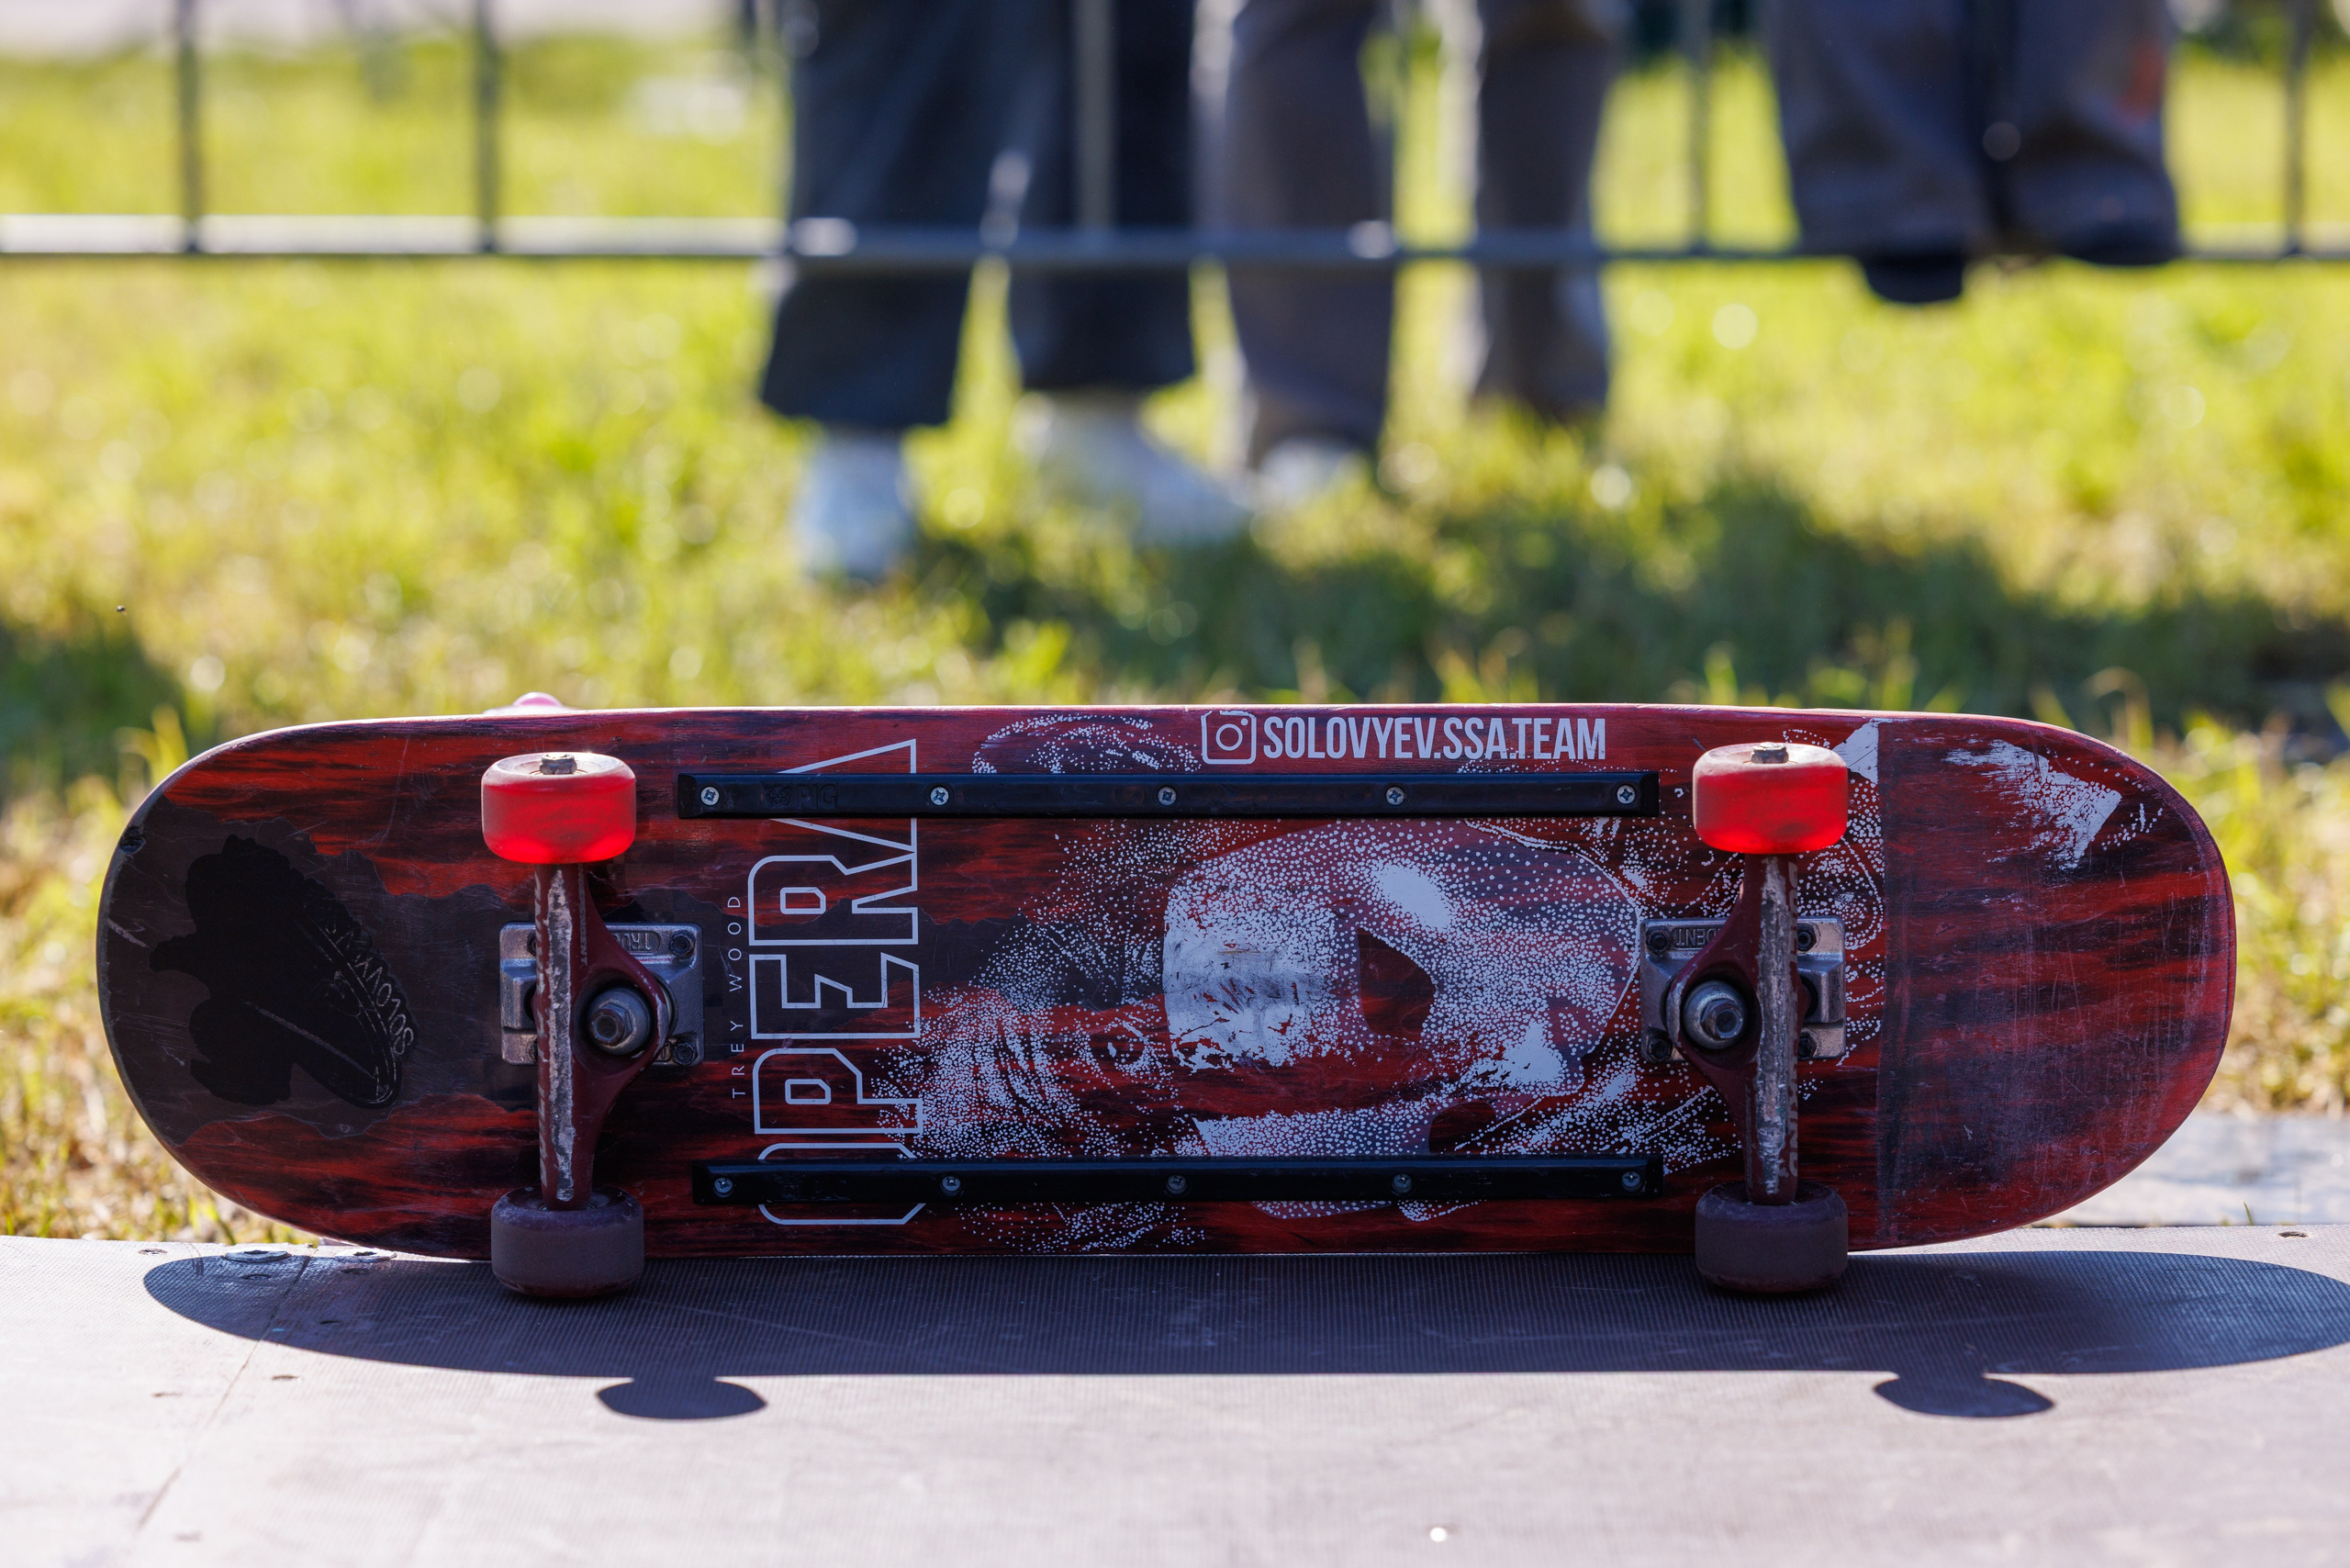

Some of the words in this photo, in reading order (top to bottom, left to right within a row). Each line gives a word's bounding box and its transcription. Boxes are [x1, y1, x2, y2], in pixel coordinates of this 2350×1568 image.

[1262, 716, 1606, 760] SOLOVYEV.SSA.TEAM
[797, 783, 838, 810] PIG
[727, 896, 743, 992] WOOD
[730, 1020, 745, 1099] TREY
